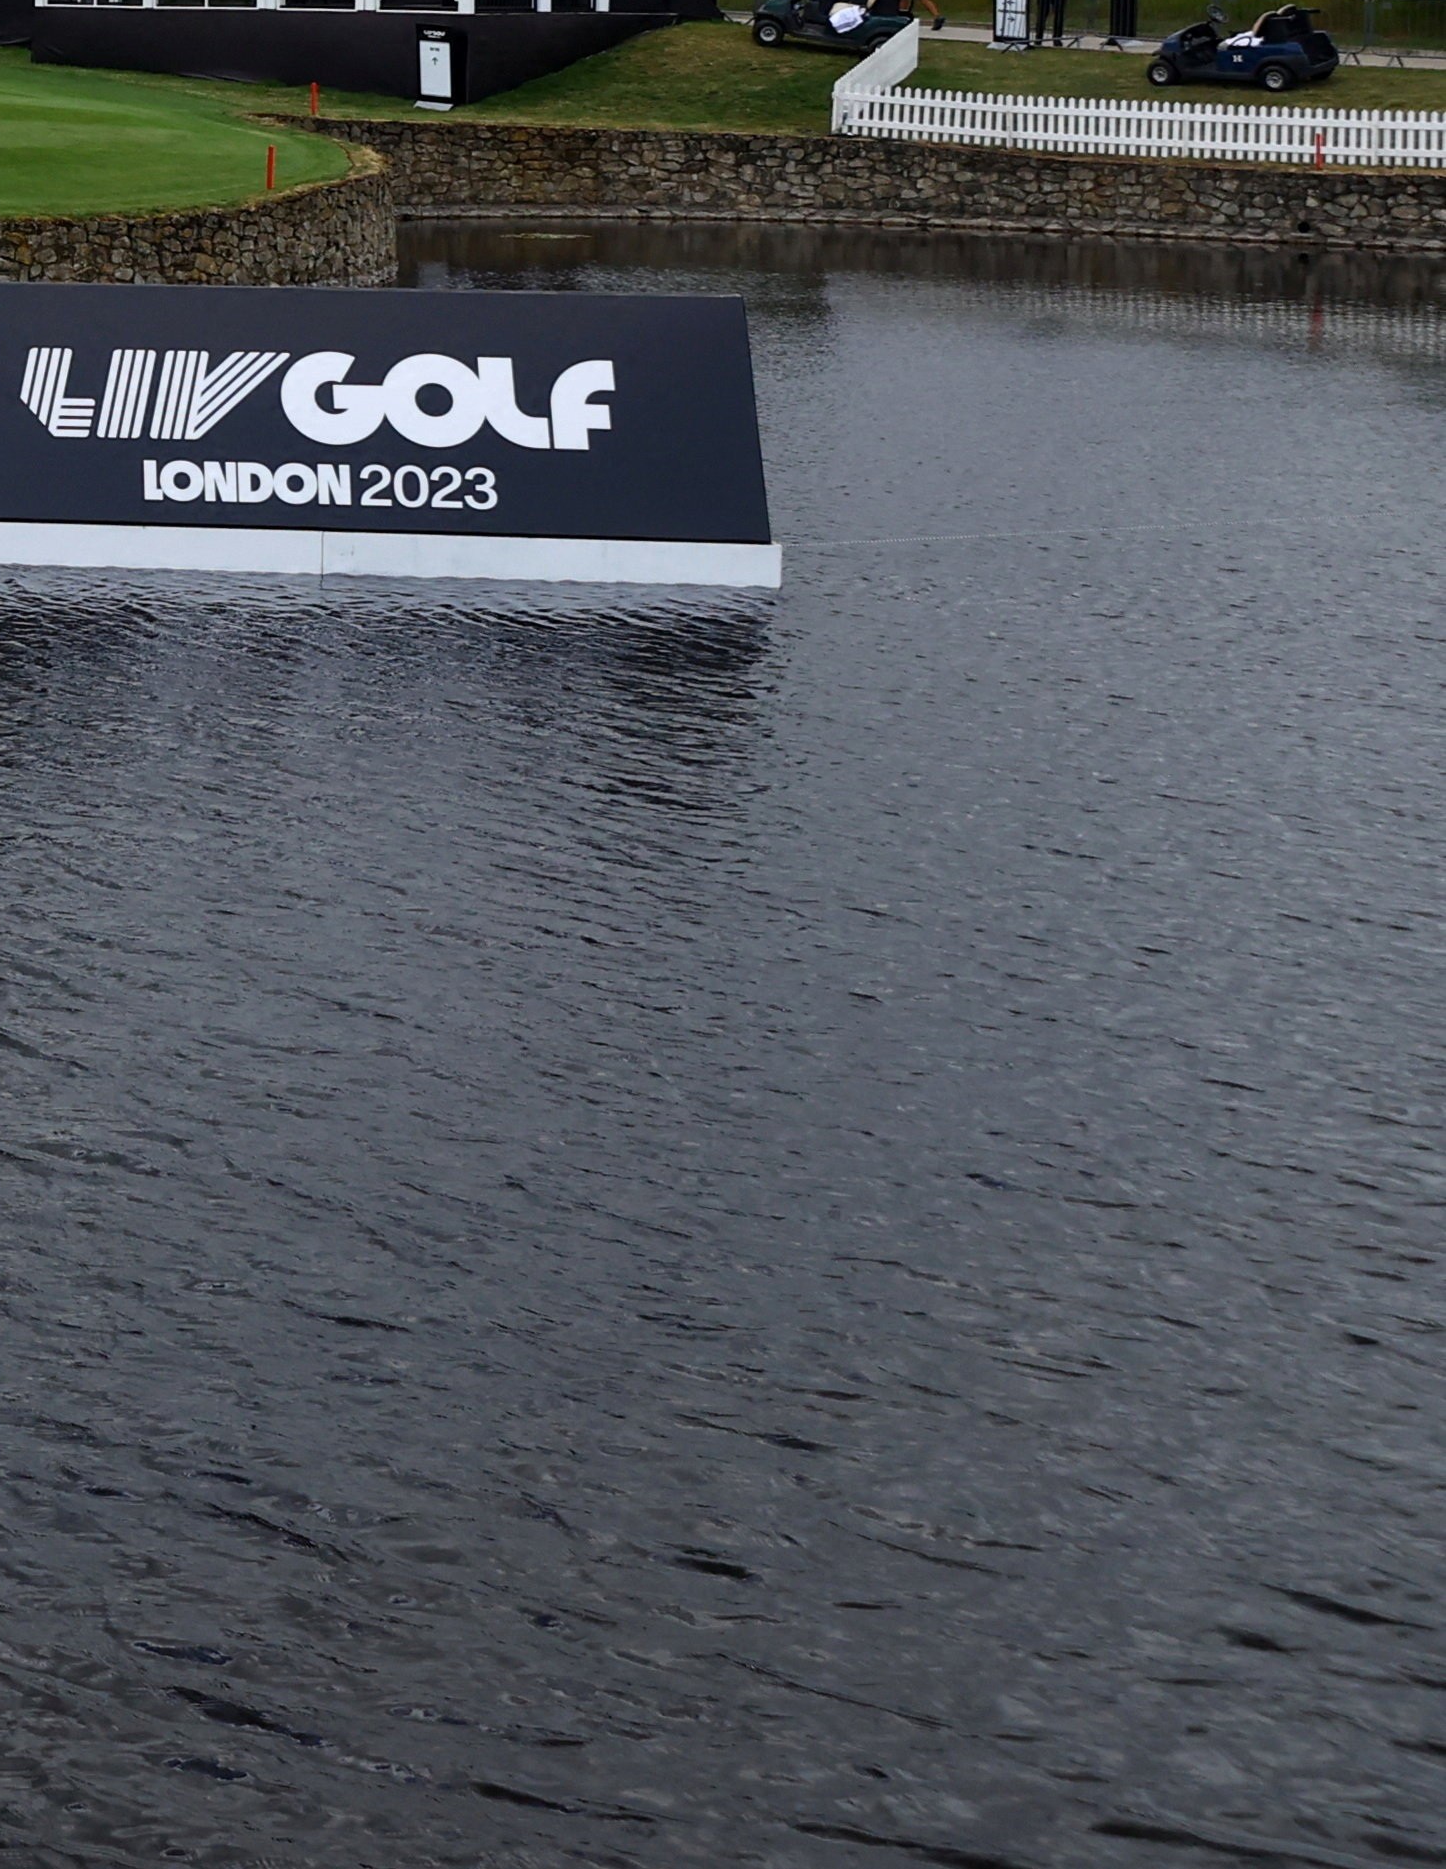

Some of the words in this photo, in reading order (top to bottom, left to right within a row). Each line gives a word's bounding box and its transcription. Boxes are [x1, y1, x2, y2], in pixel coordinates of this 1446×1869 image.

[19, 346, 291, 440] LIV
[280, 350, 616, 451] GOLF
[143, 458, 352, 506] LONDON
[359, 464, 498, 511] 2023
